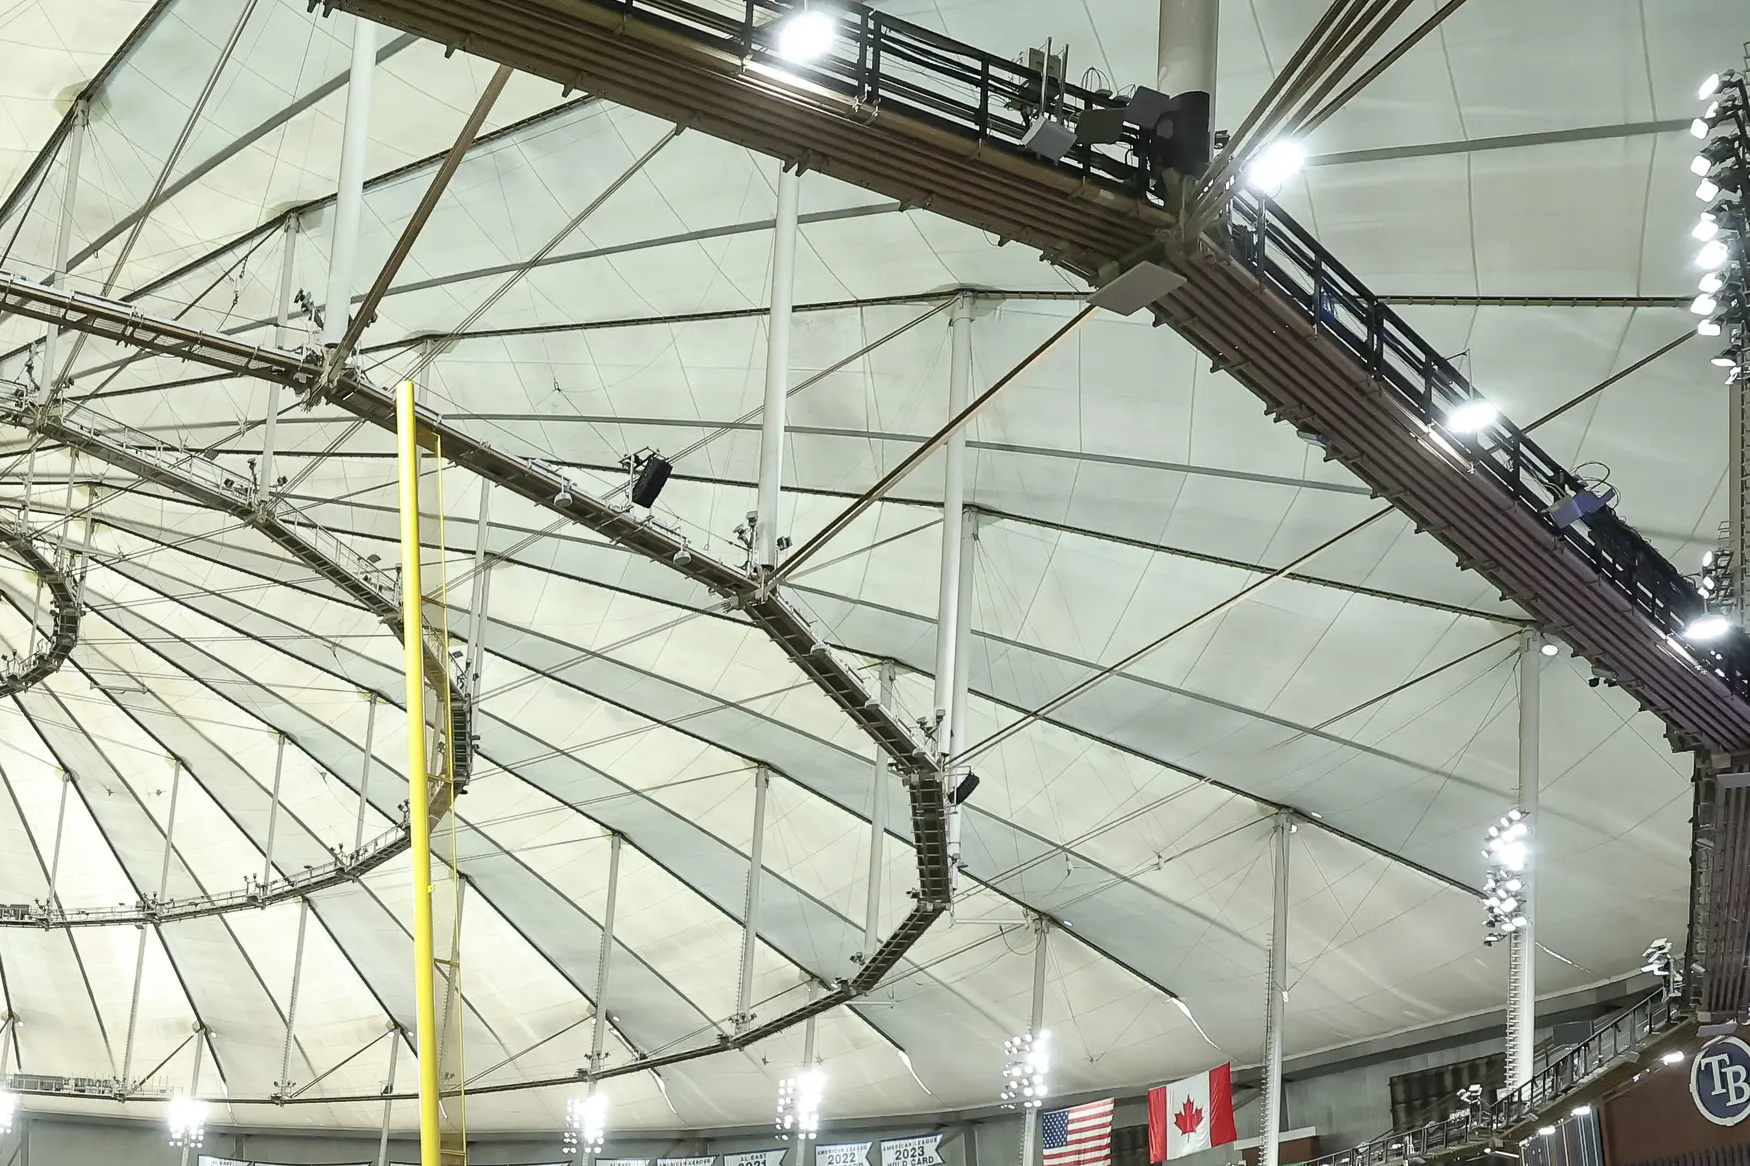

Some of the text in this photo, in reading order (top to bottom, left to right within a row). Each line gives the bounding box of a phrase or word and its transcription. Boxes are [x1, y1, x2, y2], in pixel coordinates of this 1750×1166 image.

[1701, 1053, 1750, 1106] TB
[883, 1137, 938, 1151] AMERICAN LEAGUE
[817, 1147, 844, 1155] AMERICAN
[894, 1146, 925, 1160] 2023
[827, 1152, 856, 1165] 2022
[911, 1156, 935, 1166] CARD
